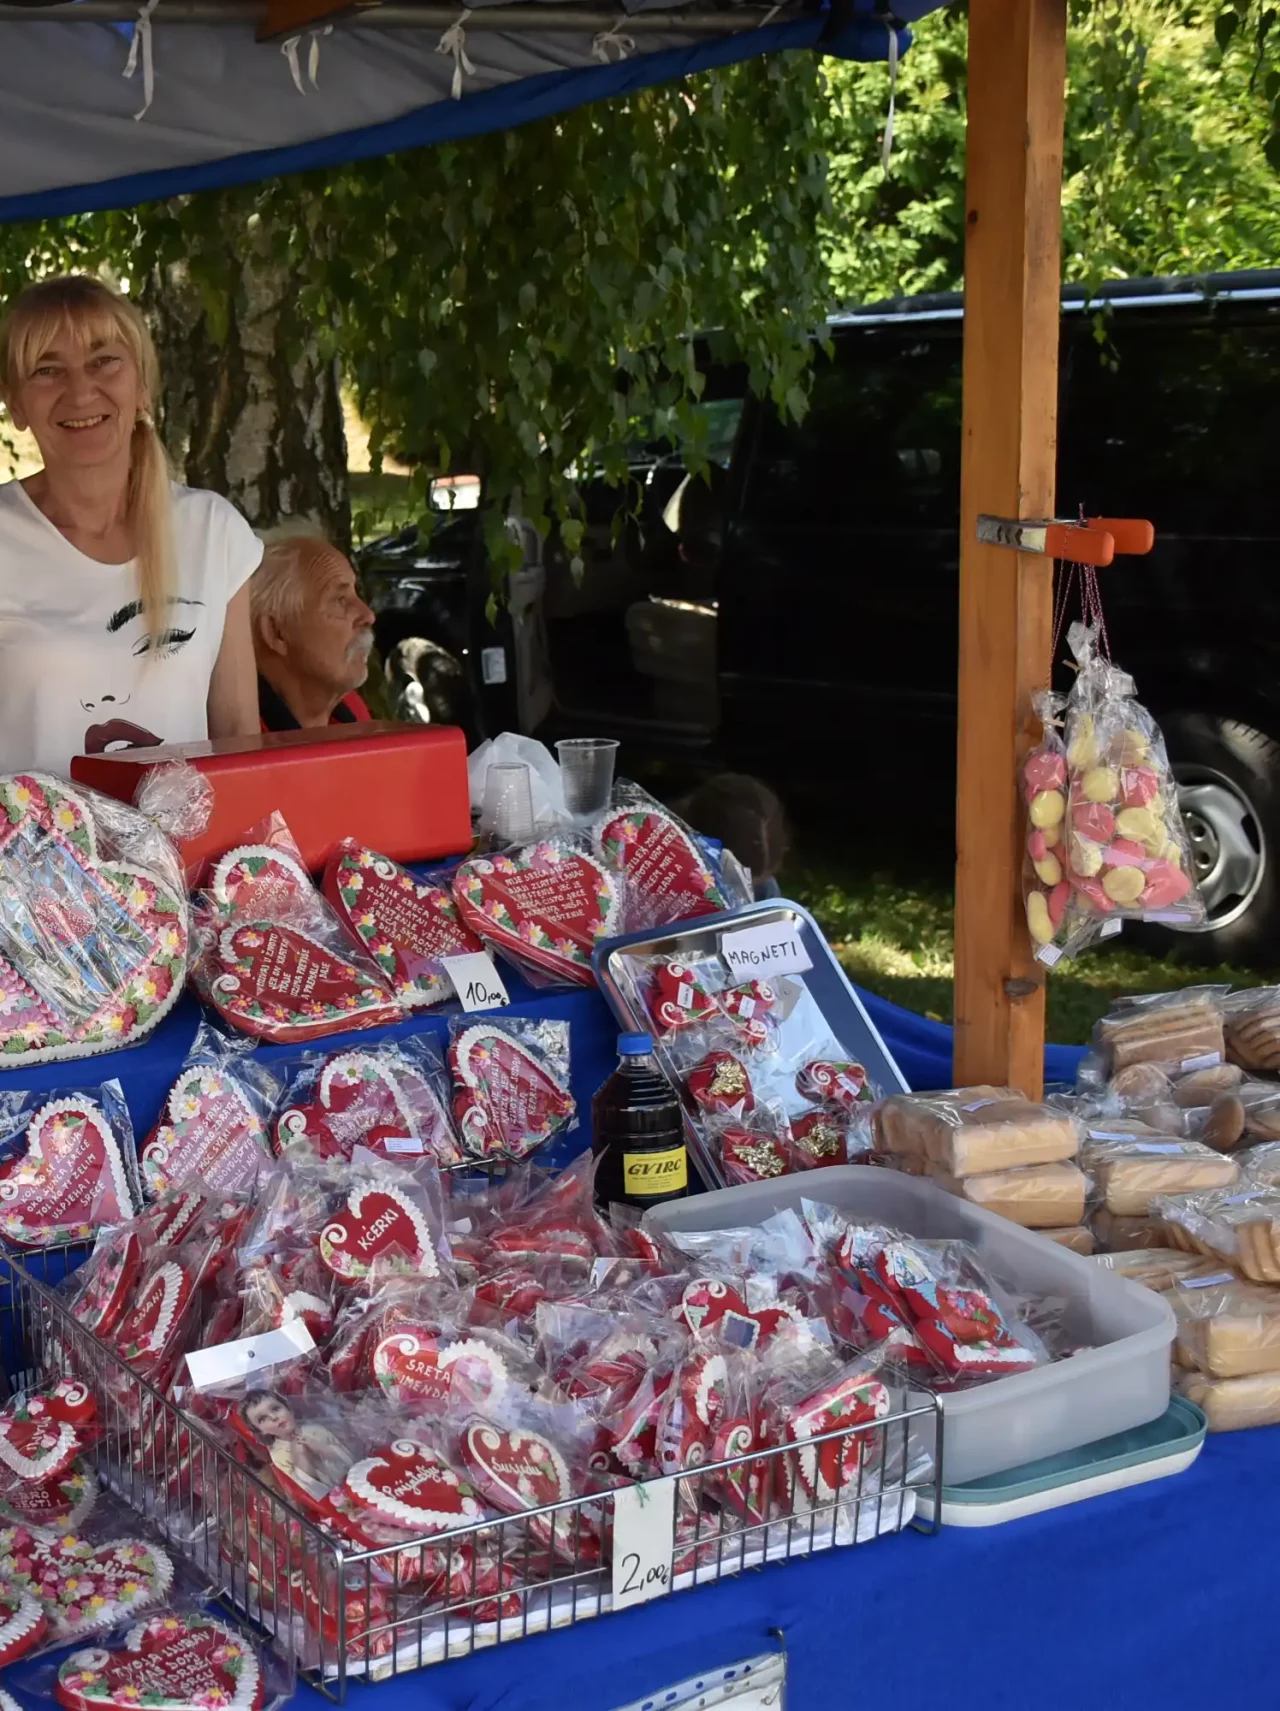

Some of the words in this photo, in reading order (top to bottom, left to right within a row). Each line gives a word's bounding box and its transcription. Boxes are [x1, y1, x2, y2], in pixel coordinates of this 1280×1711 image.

[395, 902, 428, 928] ZLATNI
[430, 925, 463, 949] LANAC
[400, 896, 430, 919] SREĆA
[431, 914, 449, 929] SVE
[449, 923, 467, 940] ŠTO
[399, 926, 448, 959] SKROMNA
[439, 940, 453, 953] JE
[727, 940, 797, 965] MAGNETI
[194, 1130, 216, 1162] DOBRO
[627, 1158, 682, 1175] GVIRC
[26, 1195, 43, 1213] OKO
[35, 1189, 63, 1218] TOLIKO
[61, 1179, 73, 1190] TI
[51, 1182, 88, 1220] USPJEHA
[356, 1207, 400, 1251] KĆERKI
[405, 1358, 462, 1388] SRETAN
[398, 1373, 461, 1407] IMENDAN
